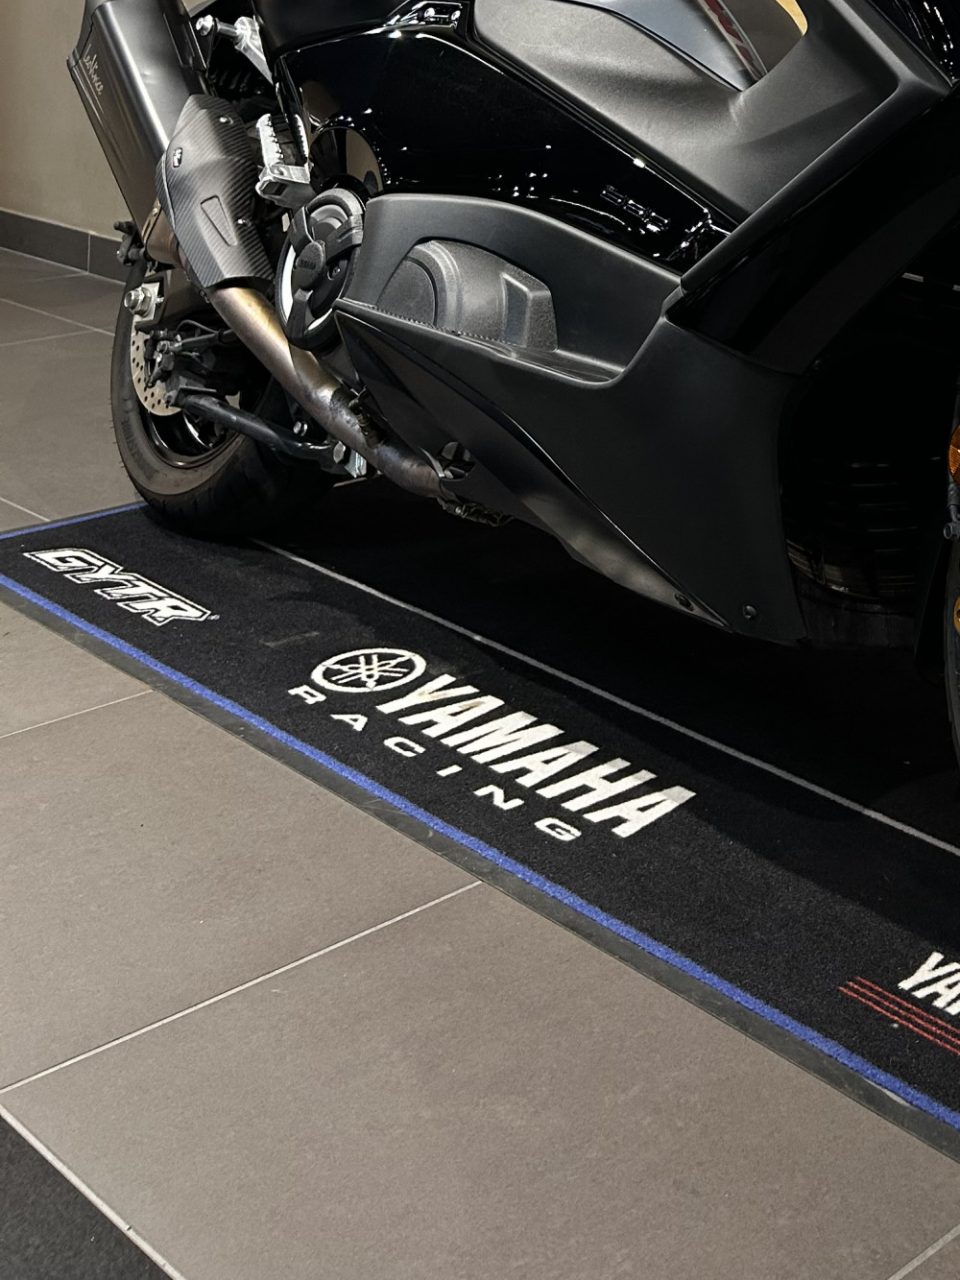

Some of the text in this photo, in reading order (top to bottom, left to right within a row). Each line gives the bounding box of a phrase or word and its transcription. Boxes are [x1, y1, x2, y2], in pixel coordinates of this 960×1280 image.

[23, 548, 212, 626] GYTR
[288, 685, 582, 843] RACING
[375, 673, 698, 839] YAMAHA
